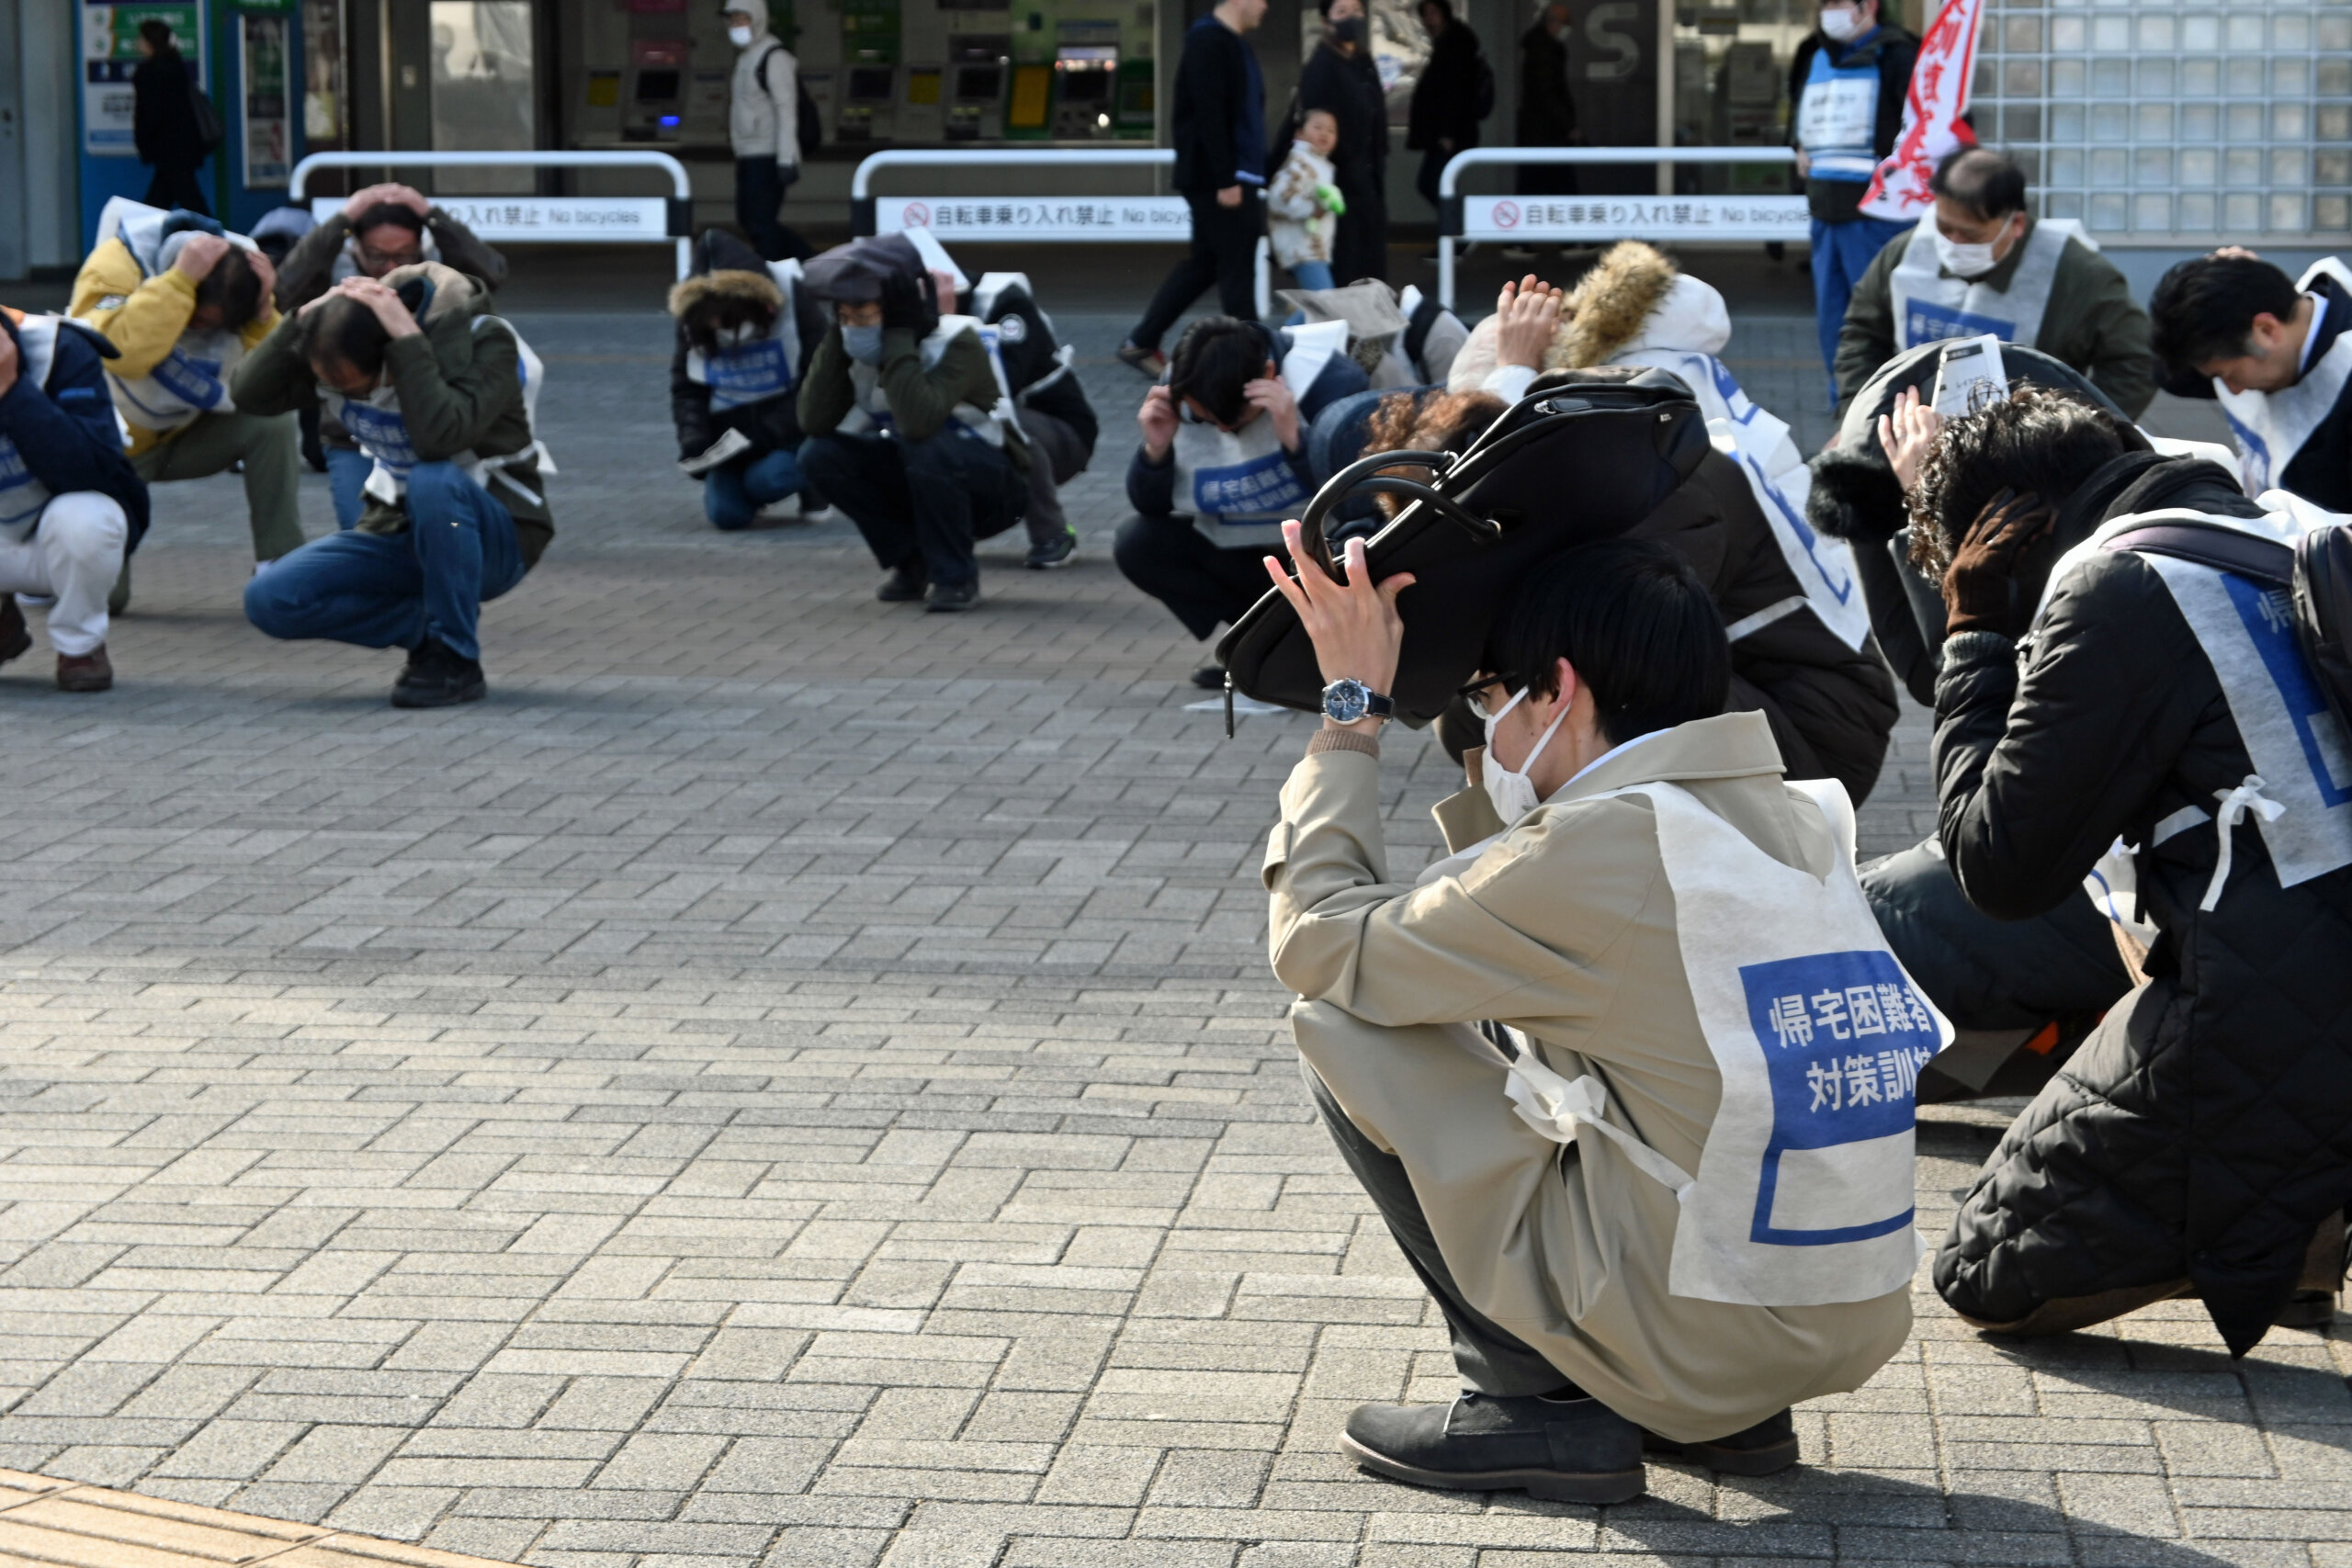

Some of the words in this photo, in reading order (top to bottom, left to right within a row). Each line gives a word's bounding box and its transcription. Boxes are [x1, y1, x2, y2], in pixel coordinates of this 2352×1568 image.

[548, 209, 570, 223] No
[575, 208, 640, 225] bicycles
[935, 205, 1114, 225] 自転車乗り入れ禁止
[1526, 204, 1713, 225] 自転車乗り入れ禁止
[1770, 983, 1932, 1049] 帰宅困難者
